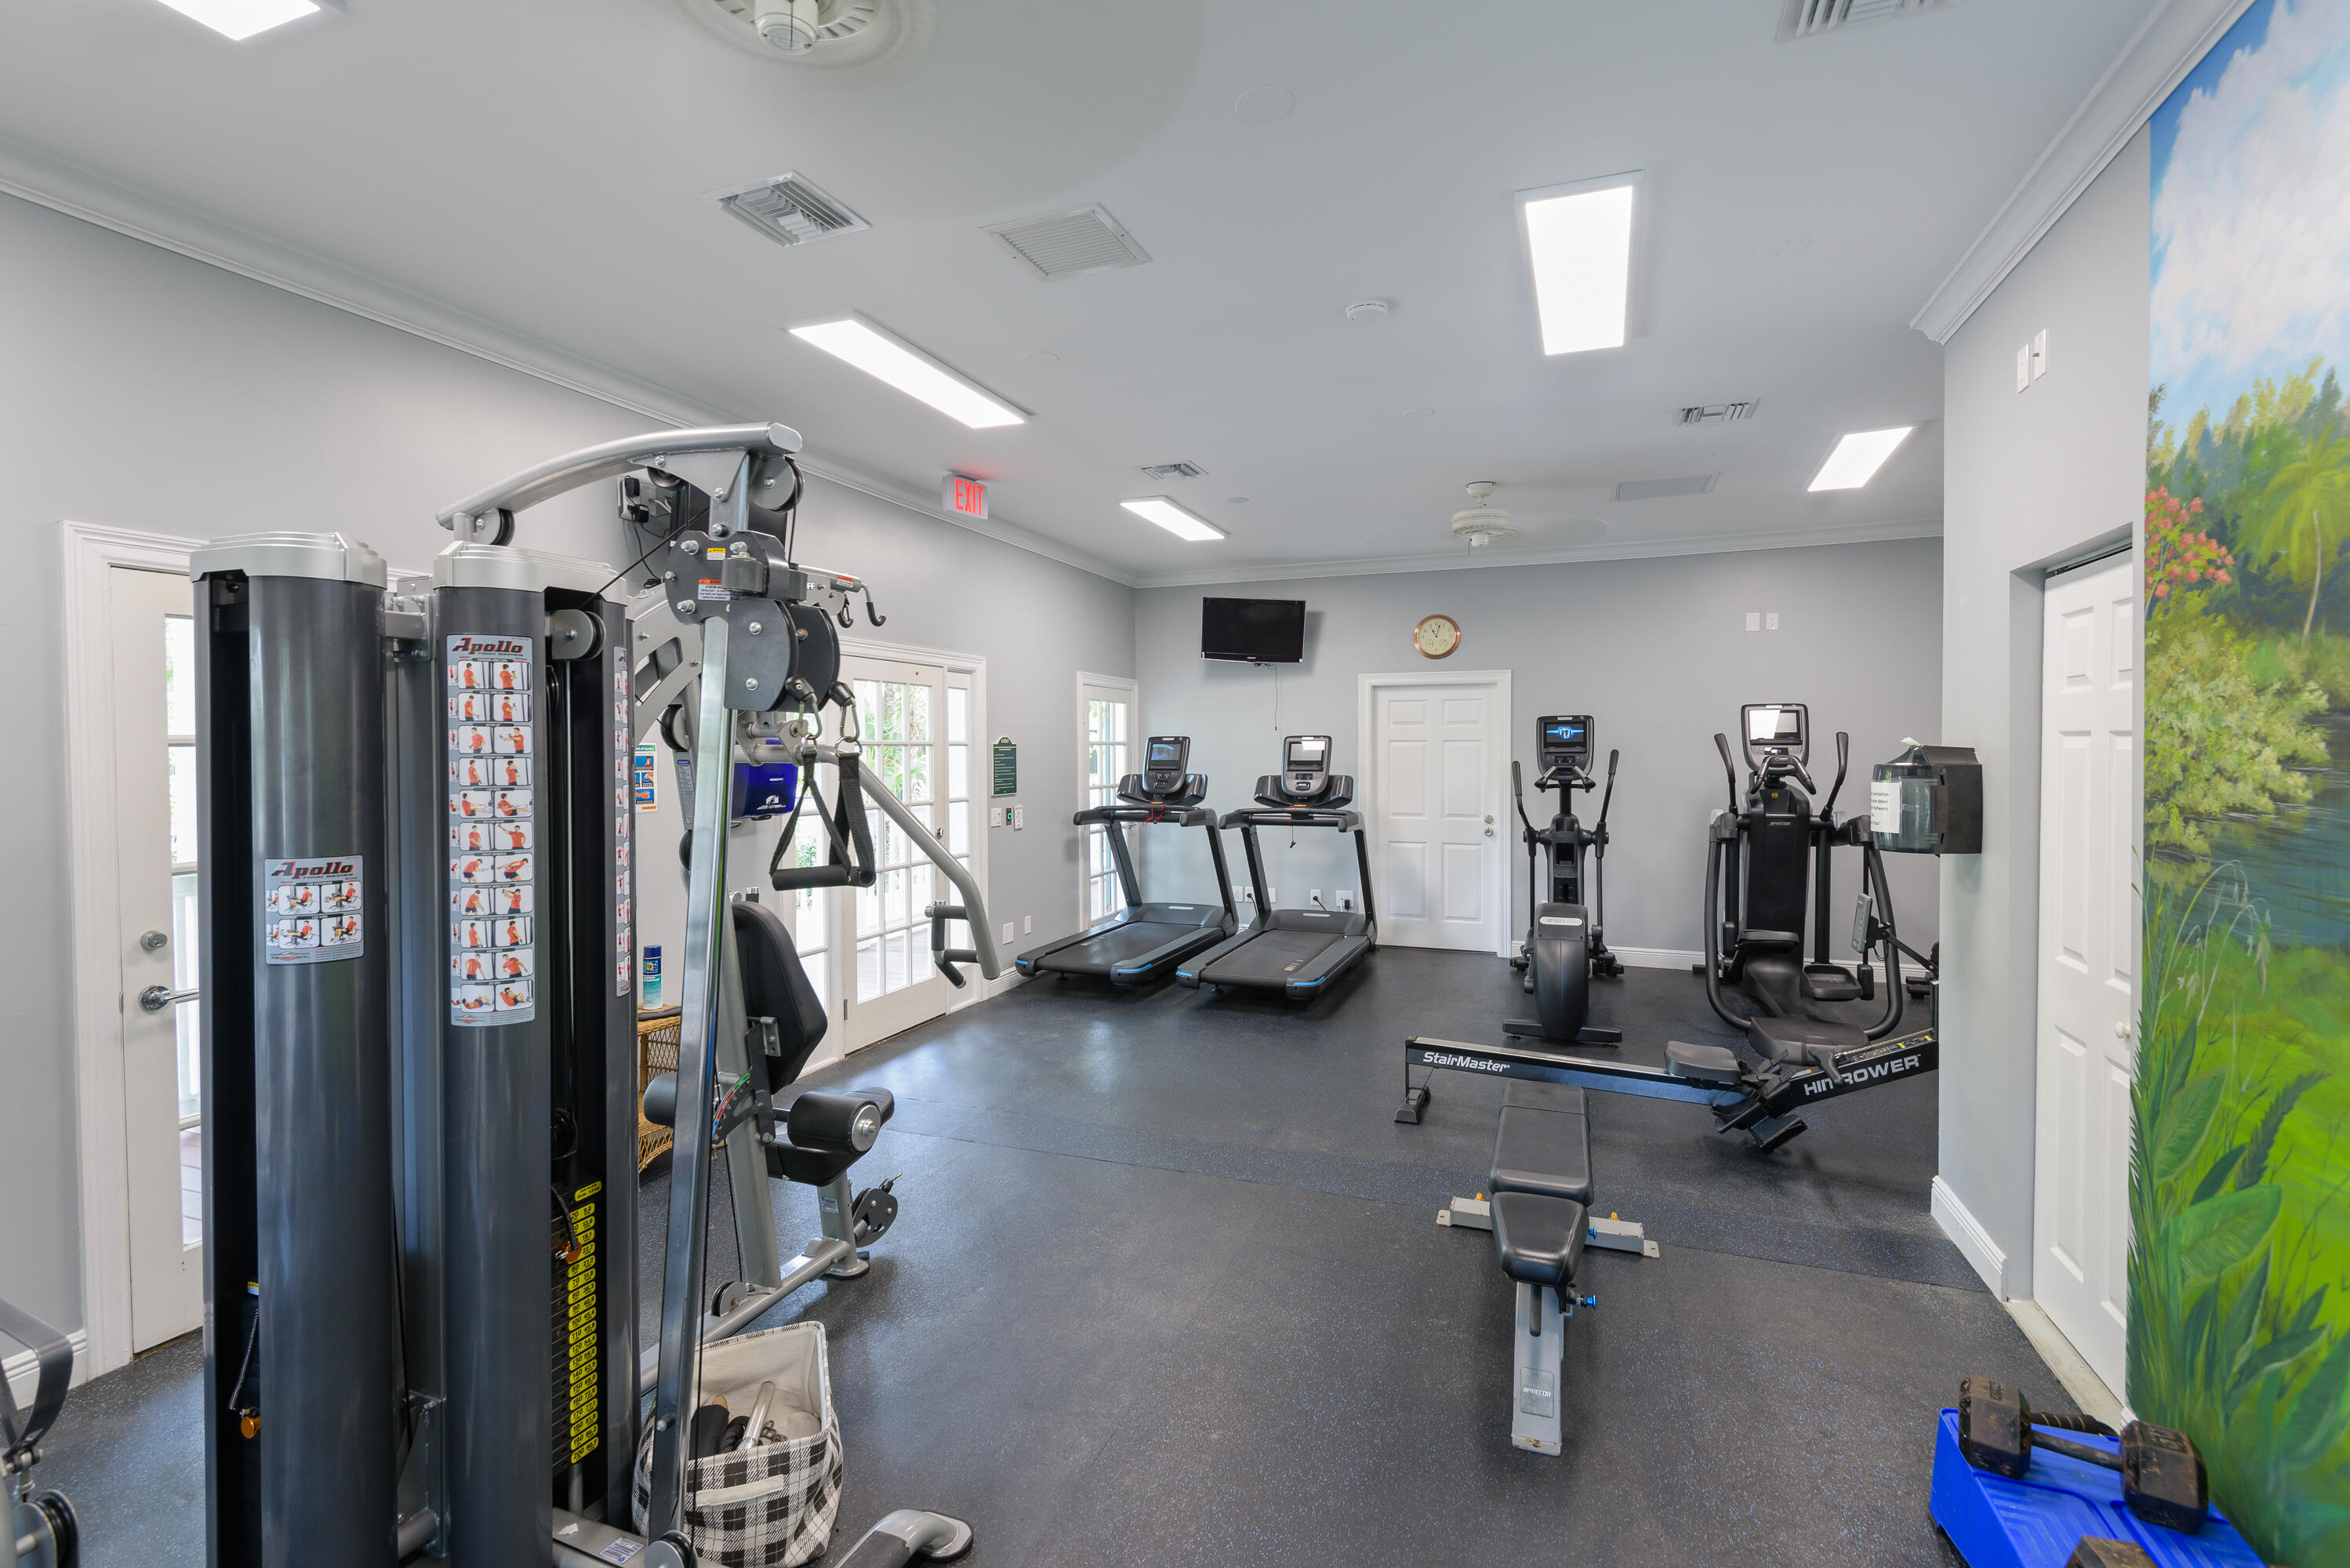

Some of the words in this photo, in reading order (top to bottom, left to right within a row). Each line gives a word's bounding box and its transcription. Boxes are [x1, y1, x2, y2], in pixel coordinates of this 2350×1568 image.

[955, 478, 983, 516] EXIT
[452, 637, 524, 655] Apollo
[271, 861, 354, 880] Apollo
[1423, 1051, 1507, 1072] StairMaster
[1840, 1055, 1920, 1084] ROWER
[572, 1265, 579, 1273] 60
[572, 1277, 579, 1286] 70
[572, 1290, 579, 1299] 80
[572, 1304, 580, 1312] 90
[572, 1316, 582, 1327] 100
[572, 1330, 582, 1340] 110
[572, 1342, 582, 1352] 120
[572, 1356, 582, 1366] 130
[572, 1369, 583, 1379] 140
[572, 1381, 583, 1392] 150
[1526, 1387, 1552, 1397] PRECOR
[572, 1396, 583, 1406] 160
[572, 1409, 583, 1419] 170
[573, 1421, 583, 1432] 180
[573, 1435, 584, 1446] 190
[573, 1447, 584, 1459] 200
